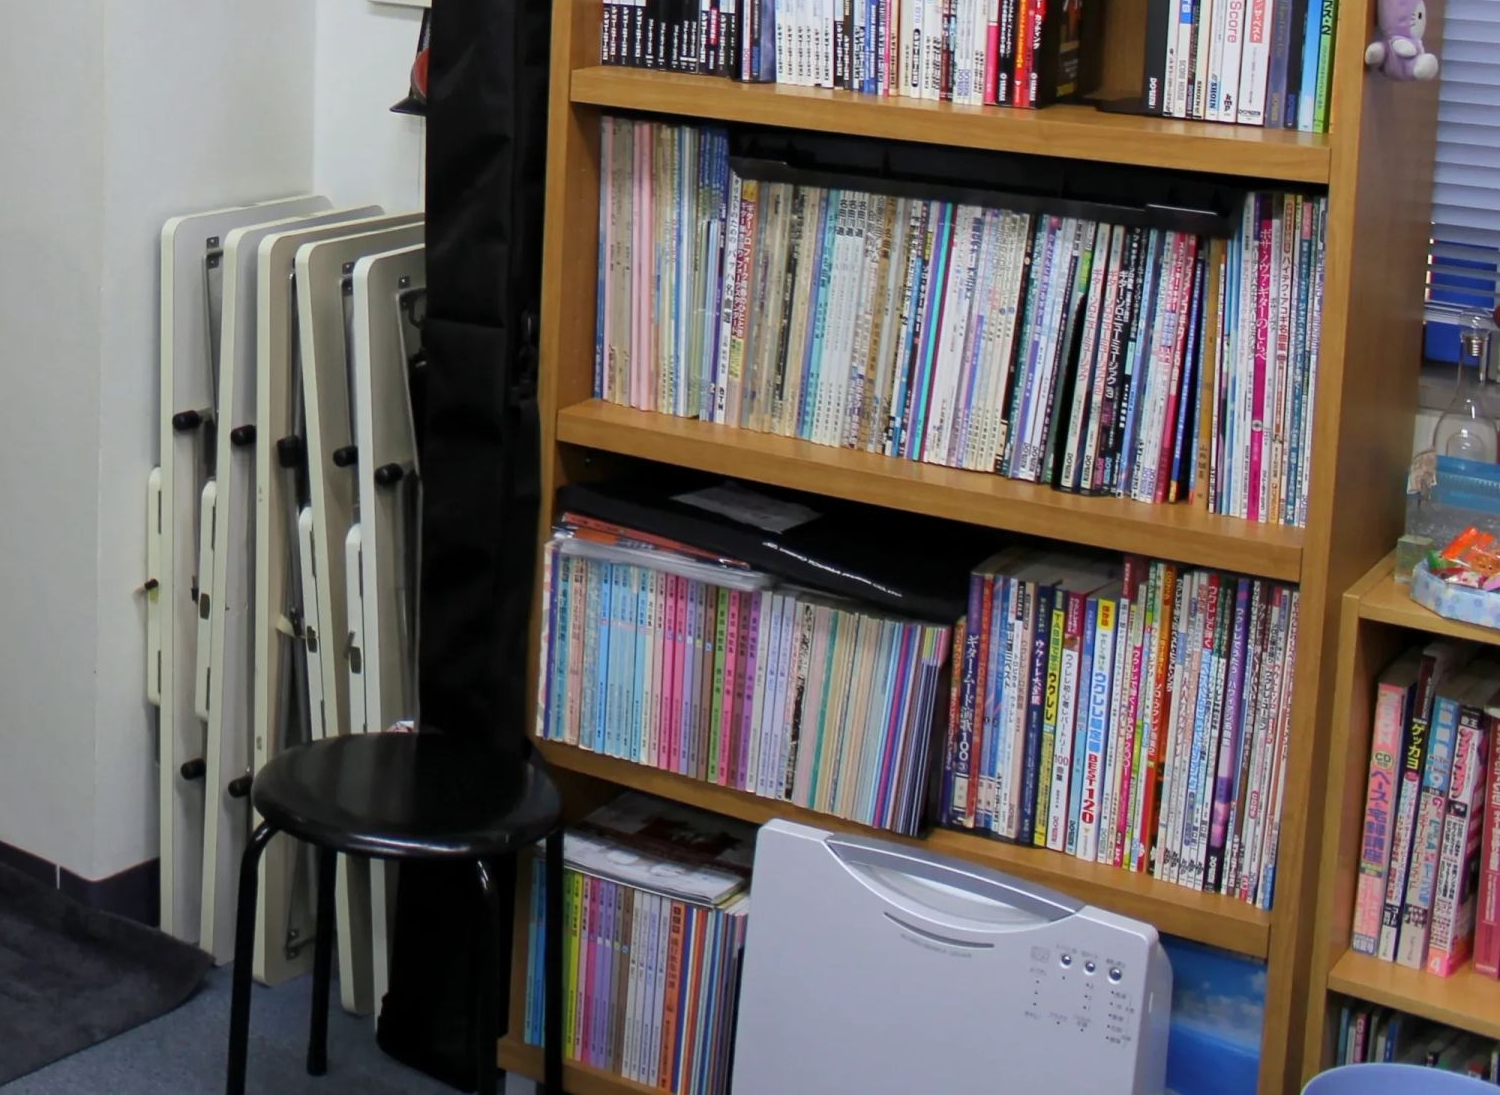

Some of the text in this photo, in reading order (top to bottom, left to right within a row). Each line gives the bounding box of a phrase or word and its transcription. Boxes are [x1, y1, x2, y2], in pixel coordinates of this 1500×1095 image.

[1228, 1, 1243, 43] Score
[1046, 672, 1058, 722] ウクレレ
[1082, 754, 1098, 824] BEST 120
